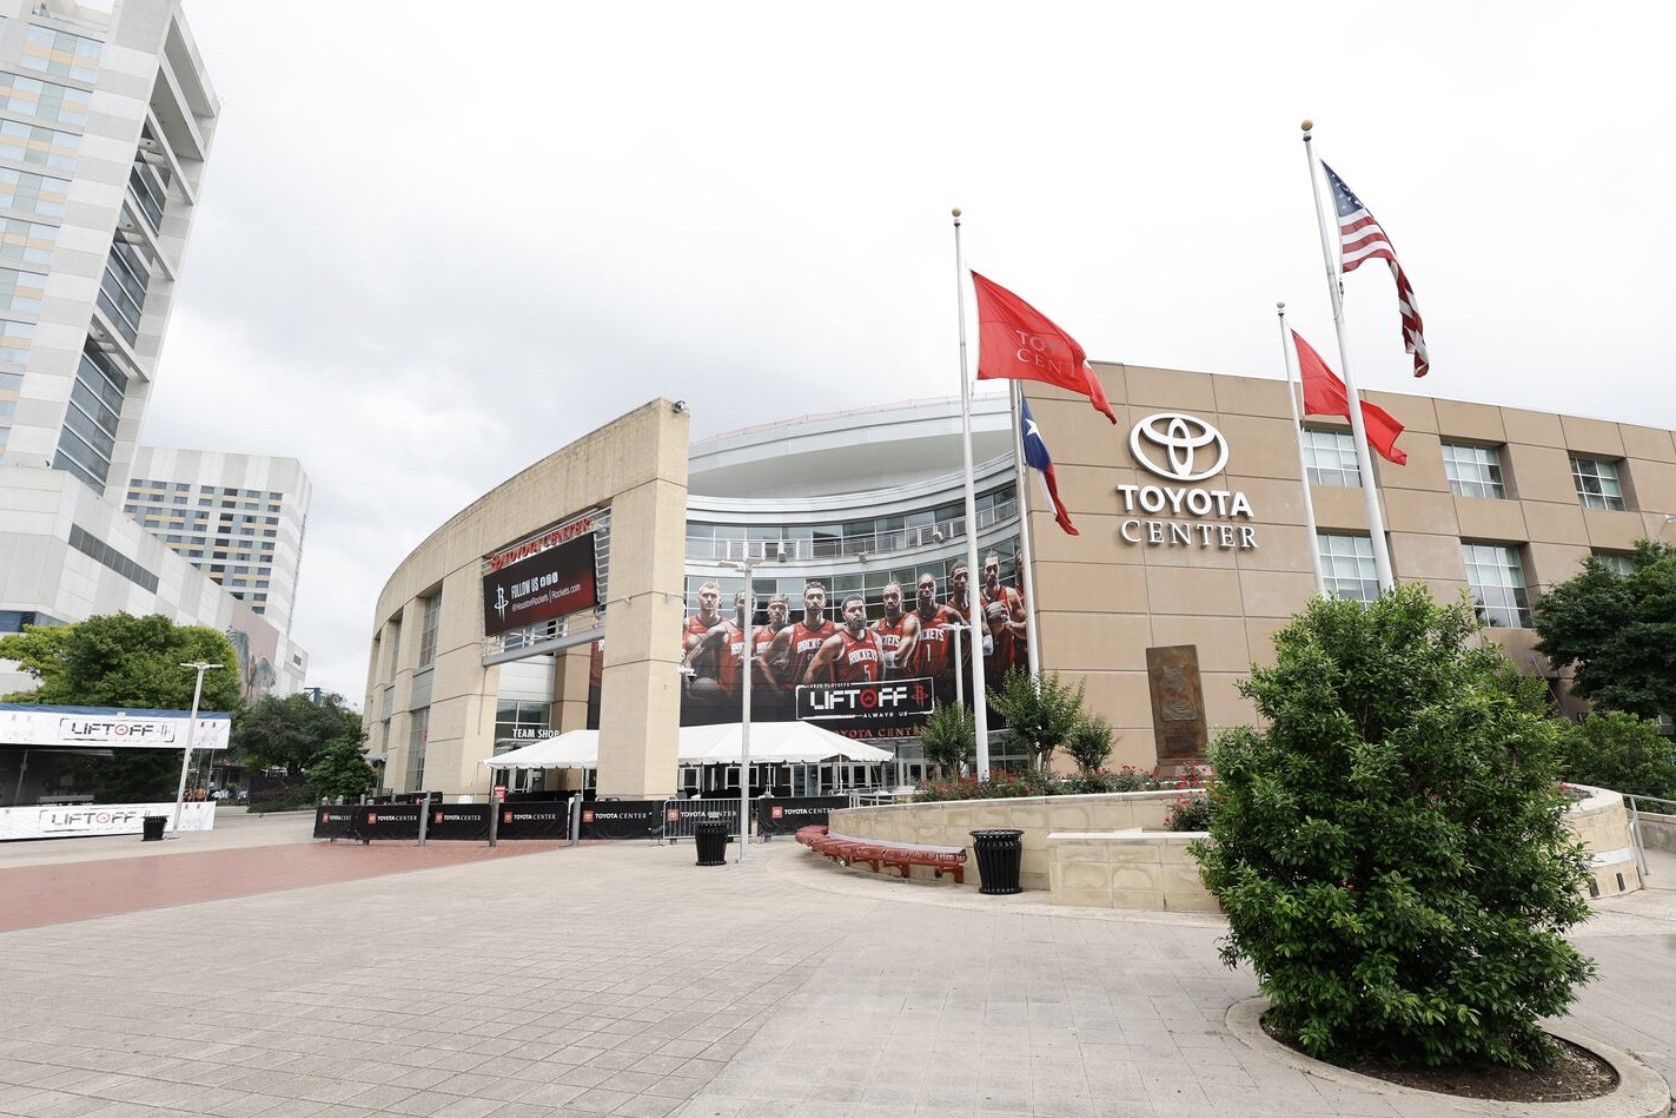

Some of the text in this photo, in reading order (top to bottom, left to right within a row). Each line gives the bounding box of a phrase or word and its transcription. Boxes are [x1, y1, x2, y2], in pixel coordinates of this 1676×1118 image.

[1117, 484, 1254, 518] TOYOTA
[1120, 520, 1259, 548] CENTER
[810, 687, 908, 710] LIFTOFF
[71, 722, 154, 736] LIFTOFF
[512, 728, 560, 738] TEAM SHOP
[51, 811, 137, 825] LIFTOFF
[808, 807, 835, 815] CENTE
